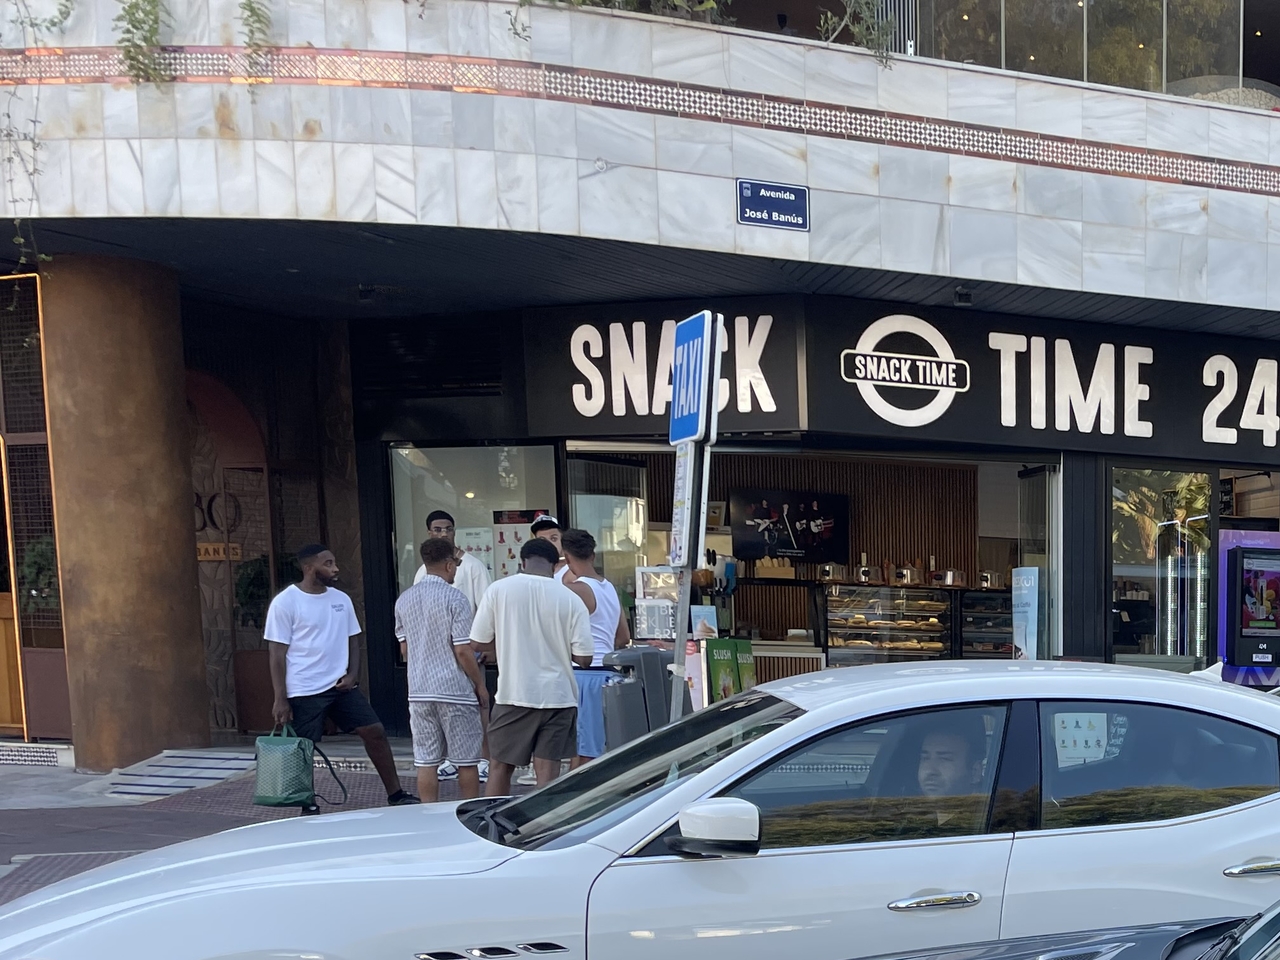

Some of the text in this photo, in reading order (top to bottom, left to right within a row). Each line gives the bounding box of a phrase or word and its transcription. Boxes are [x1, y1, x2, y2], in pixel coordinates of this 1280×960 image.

[760, 188, 795, 200] Avenida
[744, 208, 803, 224] José Banús
[674, 336, 702, 420] TAXI
[854, 355, 958, 387] SNACK TIME
[988, 331, 1154, 438] TIME
[713, 649, 732, 660] SLUSH
[737, 653, 754, 664] SLUSH
